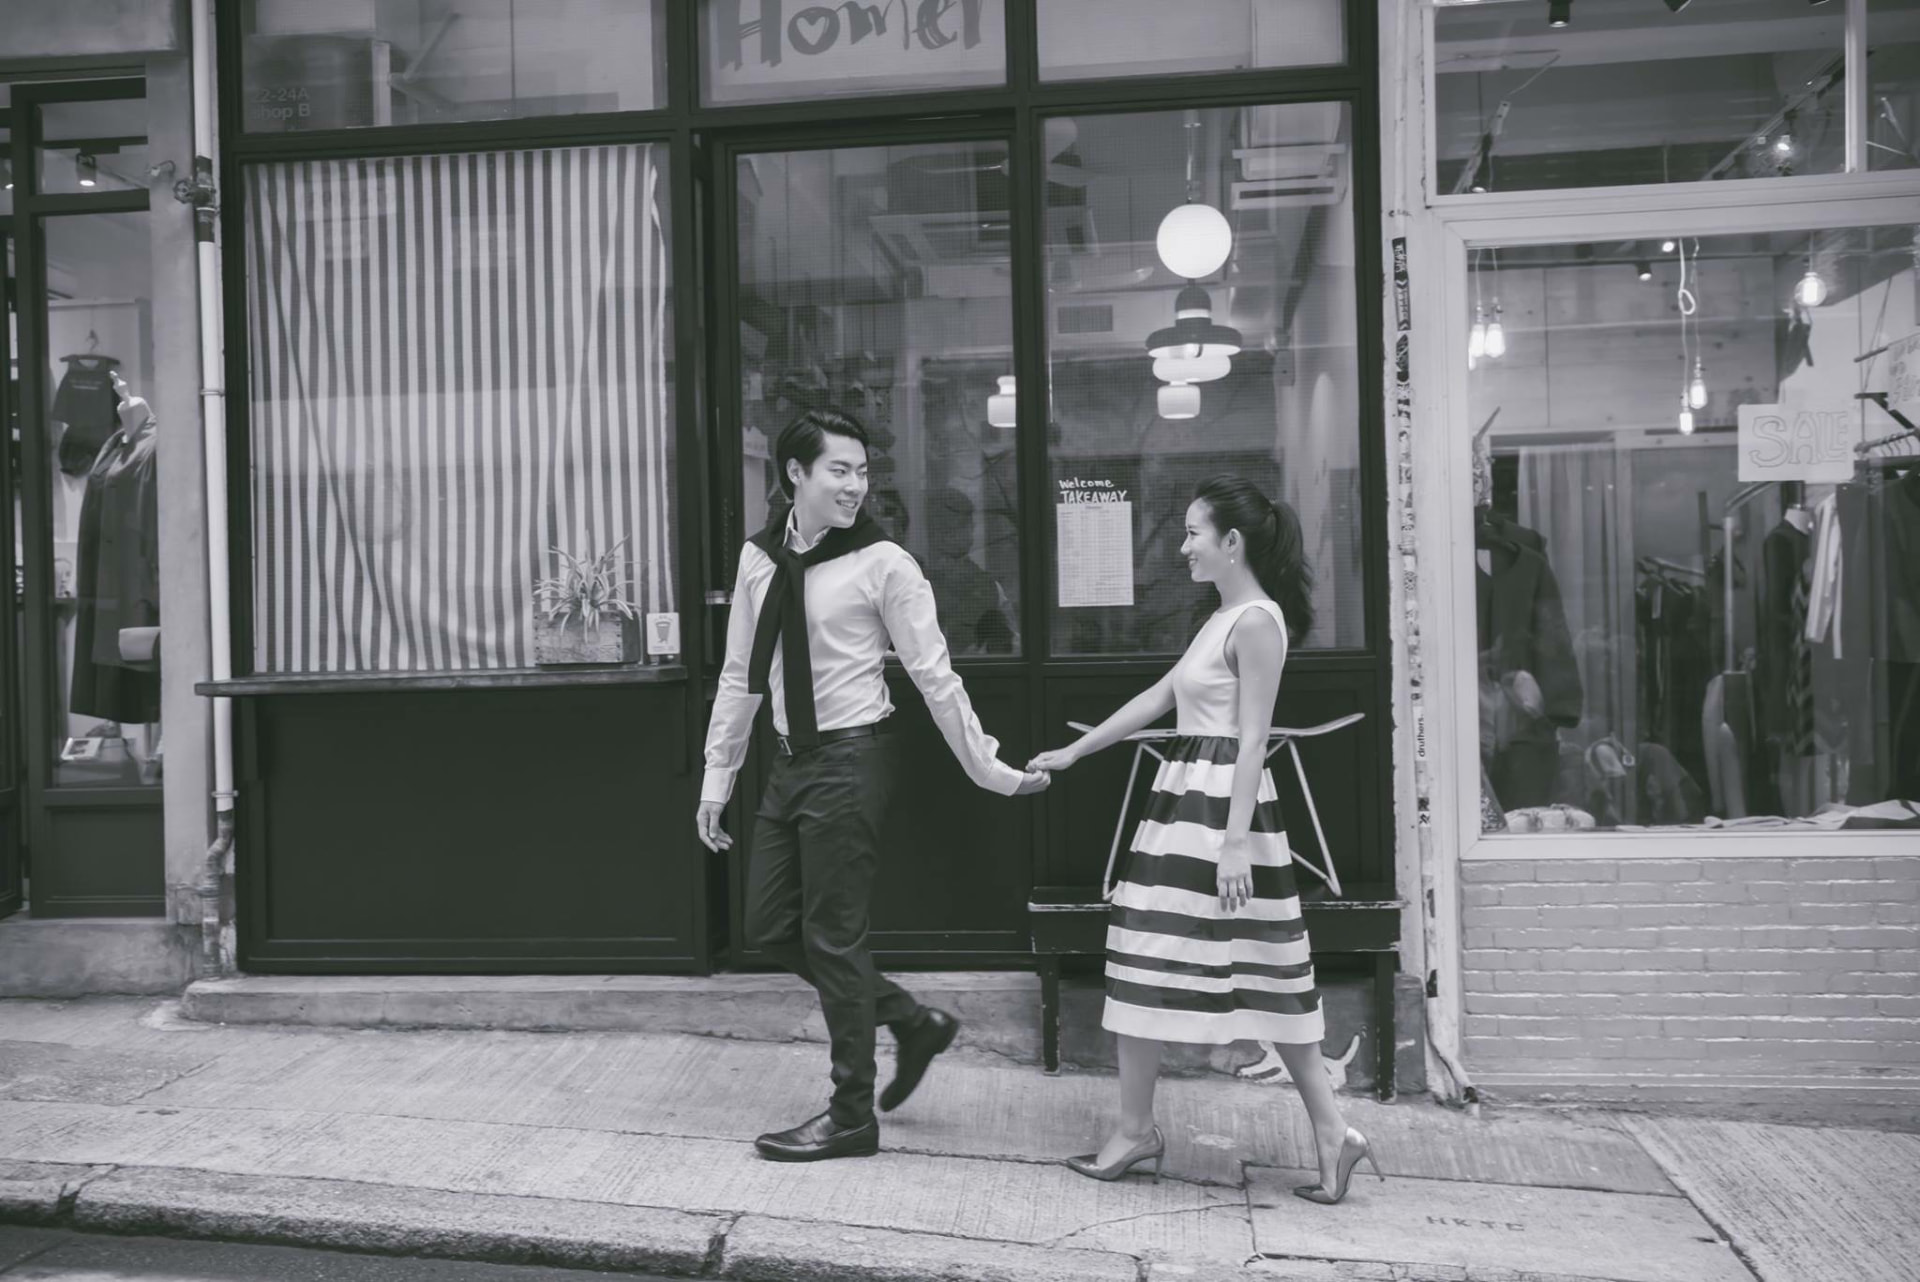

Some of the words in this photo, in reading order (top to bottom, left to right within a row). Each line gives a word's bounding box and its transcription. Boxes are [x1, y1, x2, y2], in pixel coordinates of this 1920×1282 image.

[298, 103, 312, 118] B
[1749, 411, 1849, 468] SALE
[1059, 477, 1115, 489] Welcome
[1060, 490, 1128, 504] TAKEAWAY
